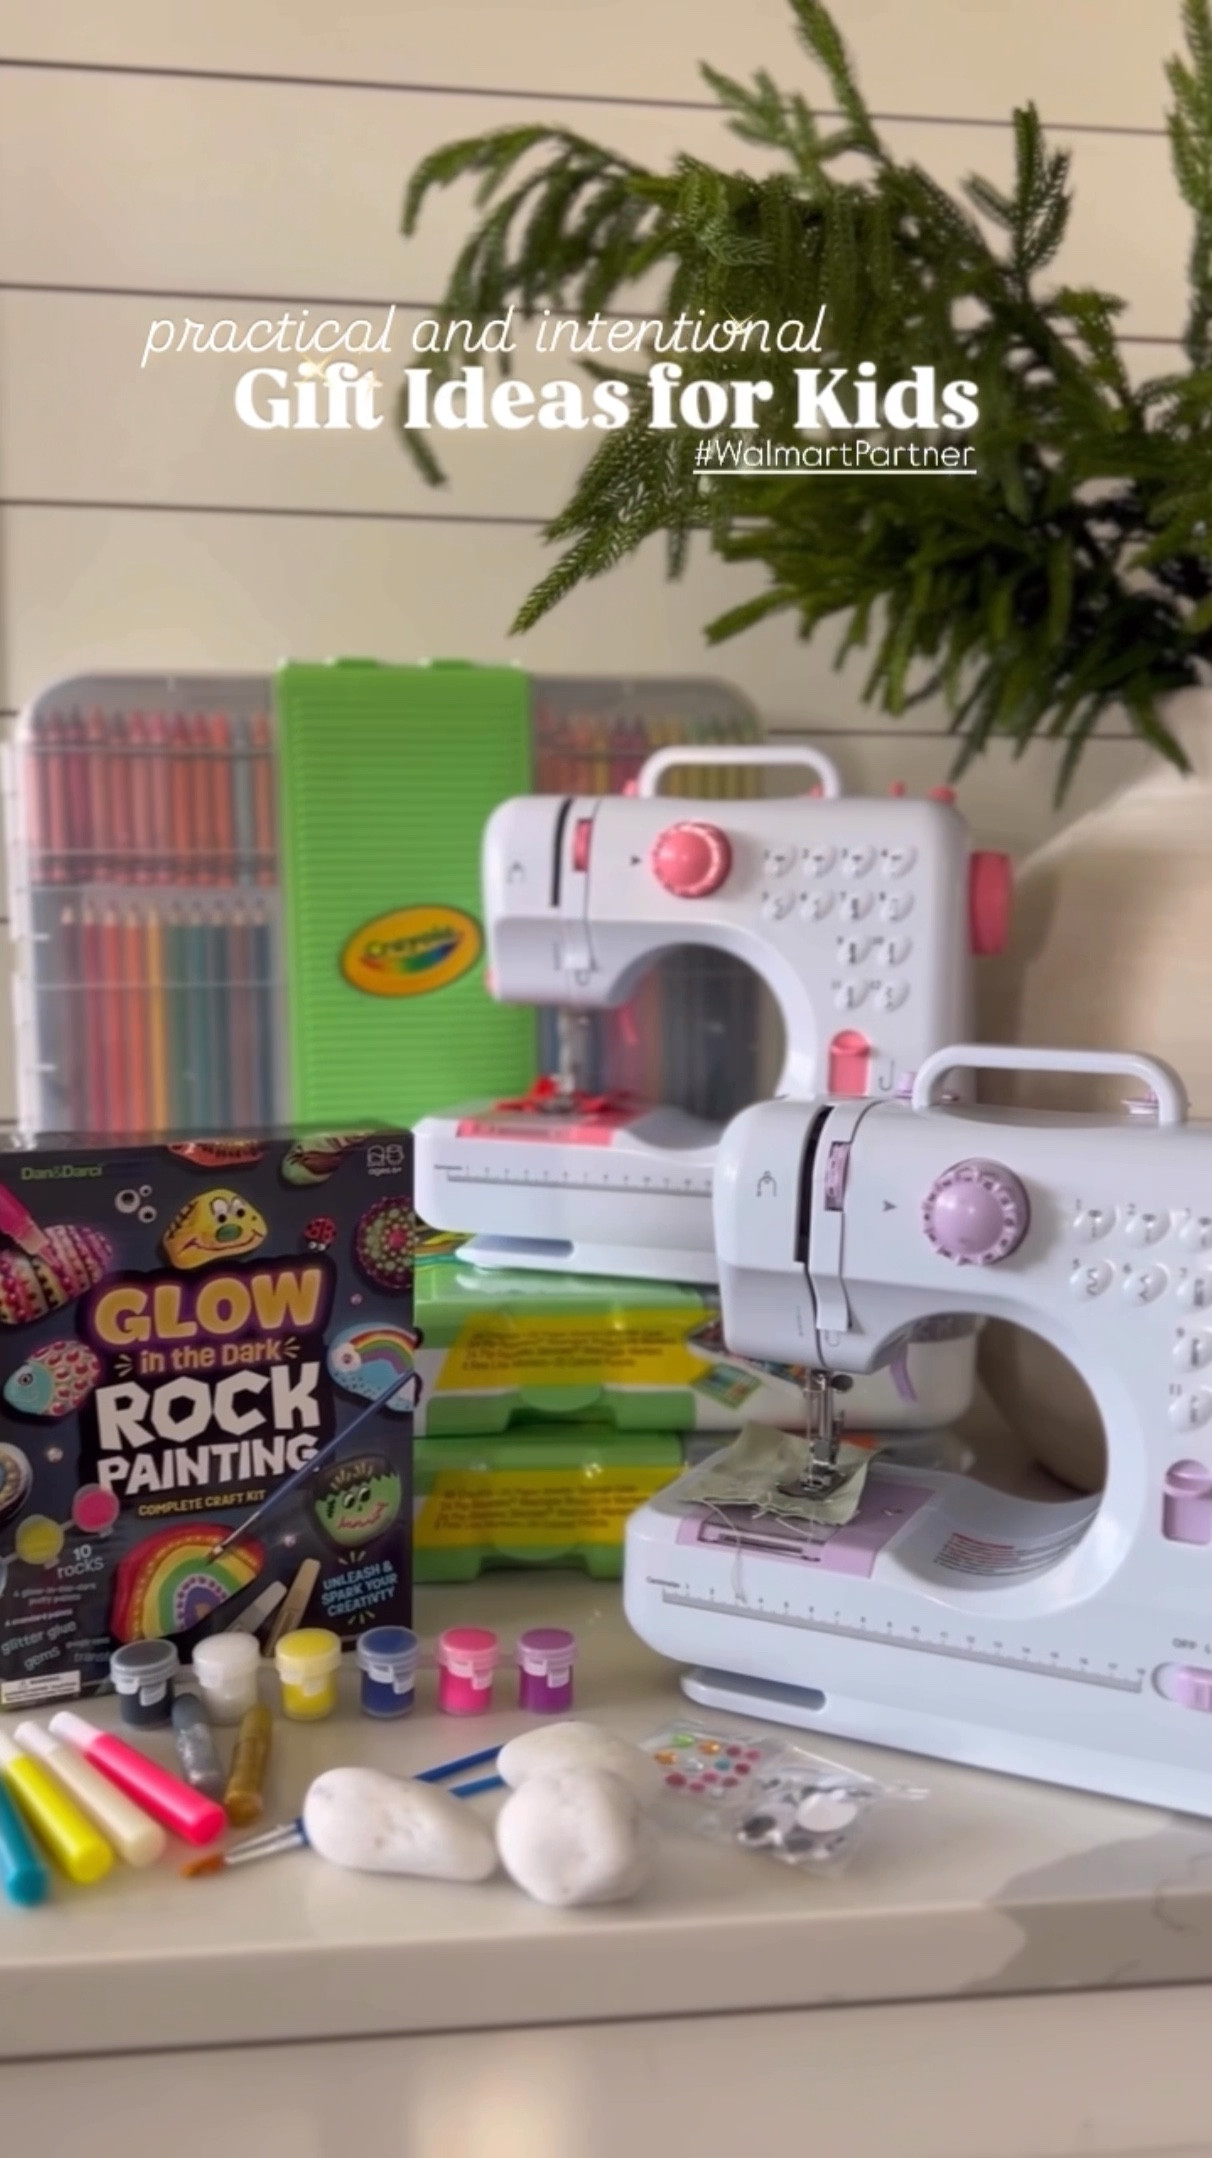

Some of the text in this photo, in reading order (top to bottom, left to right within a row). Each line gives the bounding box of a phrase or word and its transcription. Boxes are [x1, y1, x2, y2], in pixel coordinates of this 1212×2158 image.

[94, 1268, 322, 1346] GLOW
[140, 1338, 283, 1374] in the Dark
[95, 1361, 321, 1451] ROCK
[97, 1433, 320, 1497] PAINTING
[138, 1490, 266, 1518] COMPLETE CRAFT KIT
[57, 1556, 105, 1580] rocks
[72, 1544, 93, 1562] 10
[321, 1572, 398, 1606] SPARK YOUR
[323, 1560, 394, 1590] UNLEASH &
[326, 1586, 395, 1617] CREATIVITY
[1, 1621, 77, 1656] glitter glue
[24, 1645, 60, 1671] gems
